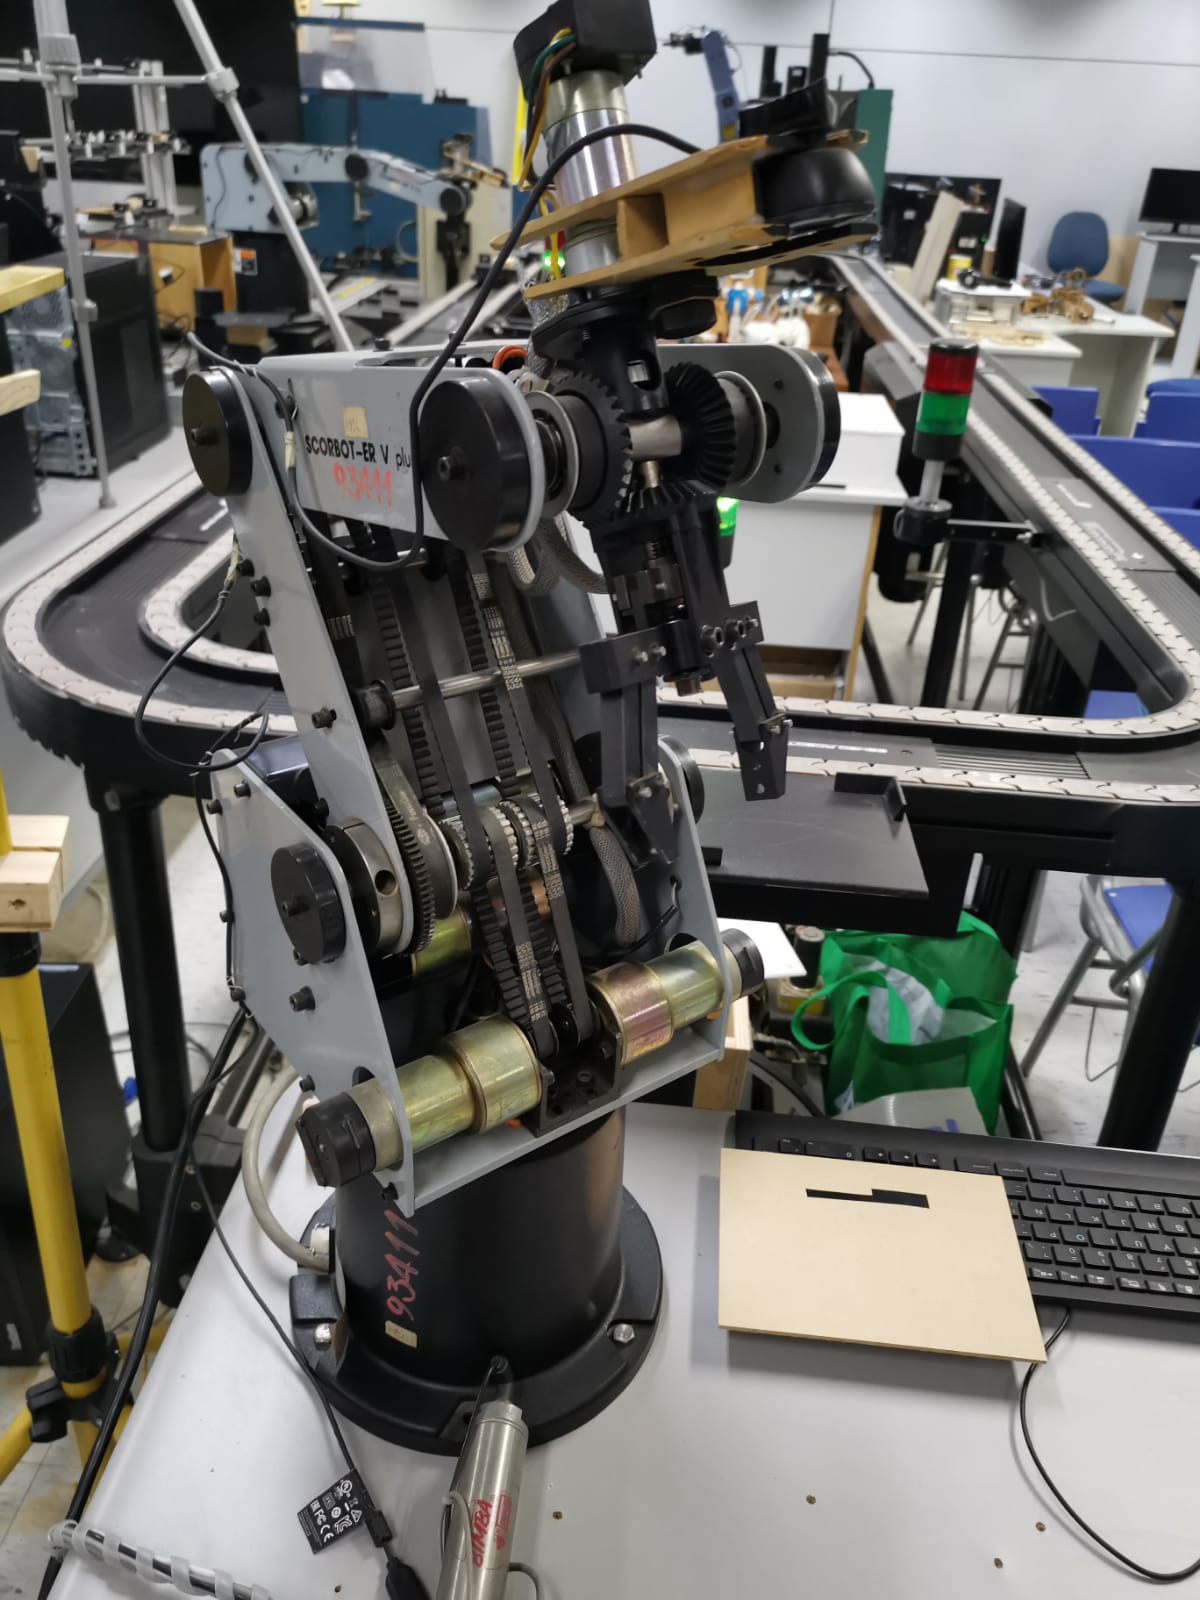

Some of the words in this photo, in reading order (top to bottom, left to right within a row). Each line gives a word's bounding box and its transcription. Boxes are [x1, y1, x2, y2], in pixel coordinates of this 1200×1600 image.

[304, 434, 377, 463] SCORBOT-ER
[379, 443, 389, 465] V
[394, 446, 412, 472] plu
